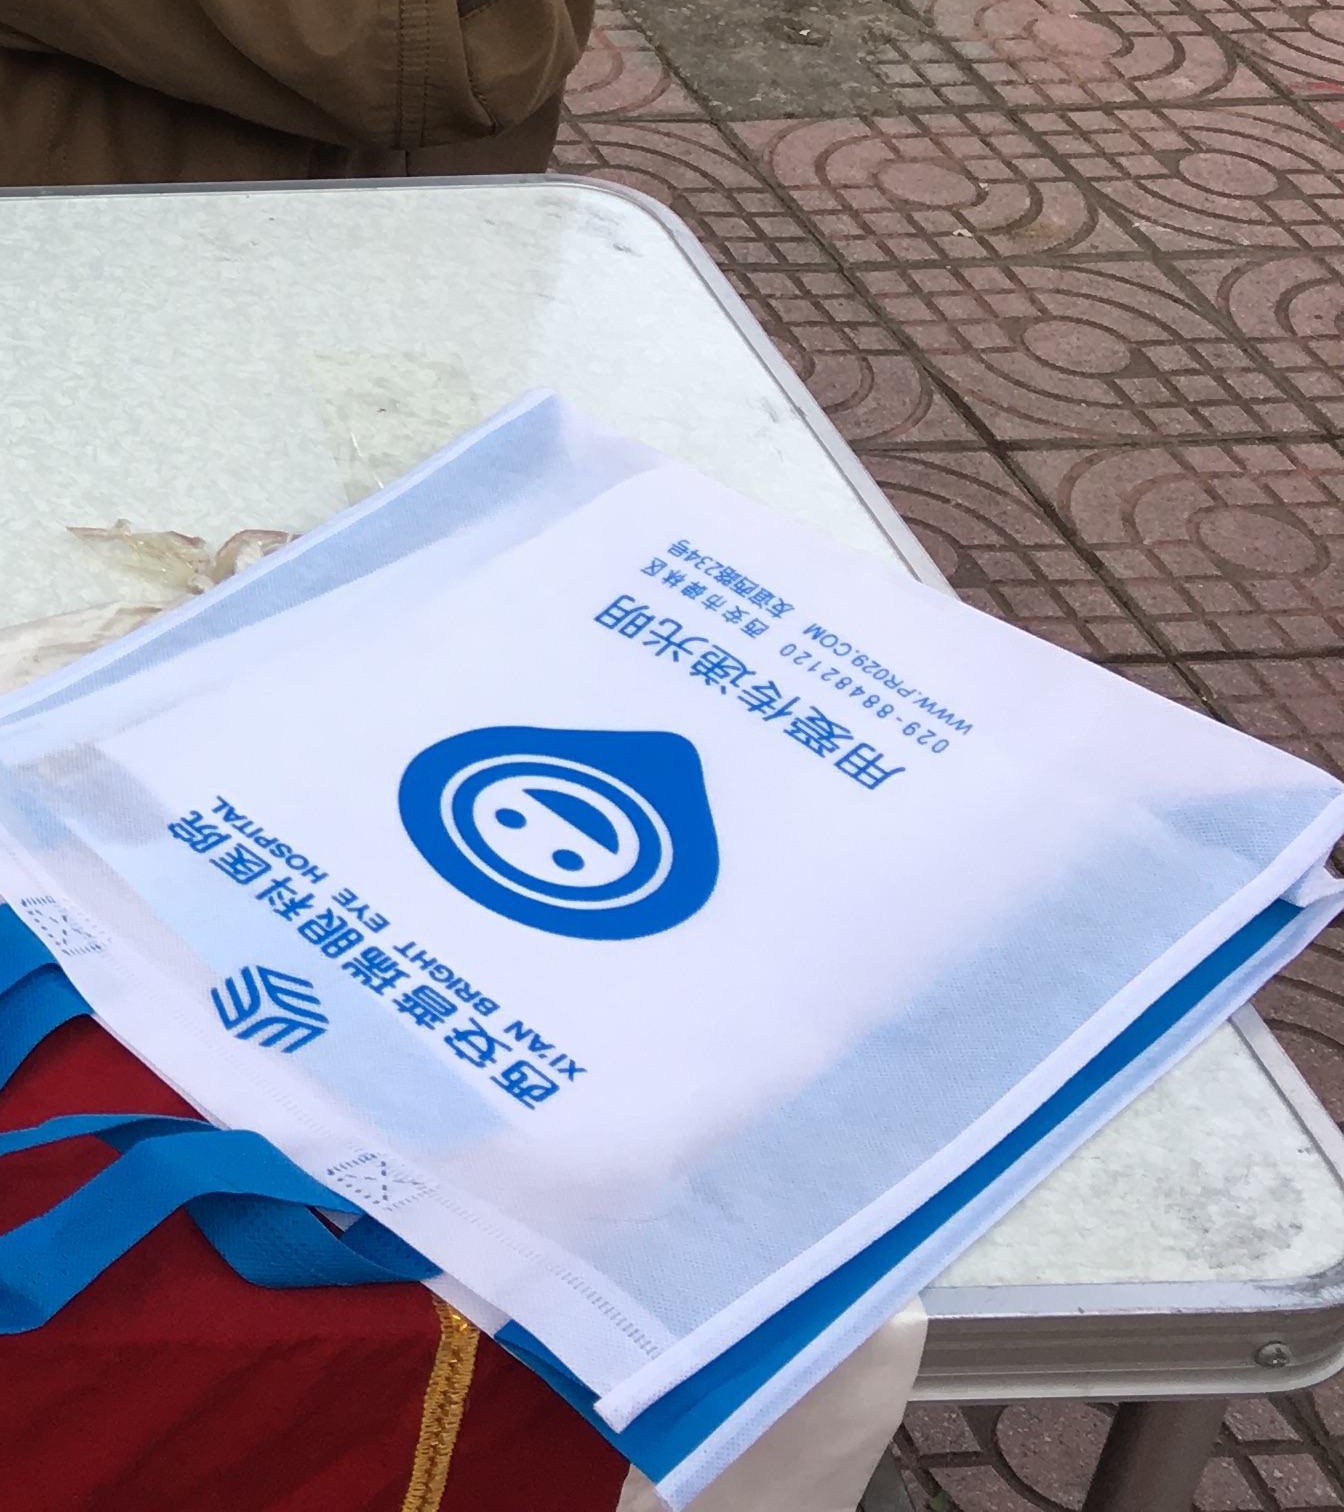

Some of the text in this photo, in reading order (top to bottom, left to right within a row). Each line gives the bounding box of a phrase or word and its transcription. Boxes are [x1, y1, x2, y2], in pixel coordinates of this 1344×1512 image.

[641, 556, 771, 640] 西安市碑林区
[666, 539, 796, 620] 友谊西路234号
[593, 594, 906, 791] 用爱传递光明
[779, 643, 951, 755] 029-88482120
[802, 622, 974, 736] WWW.PR029.COM
[214, 795, 329, 885] HOSPITAL
[333, 888, 390, 934] EYE
[167, 809, 561, 1111] 西安普瑞眼科医院
[394, 940, 501, 1018] BRIGHT
